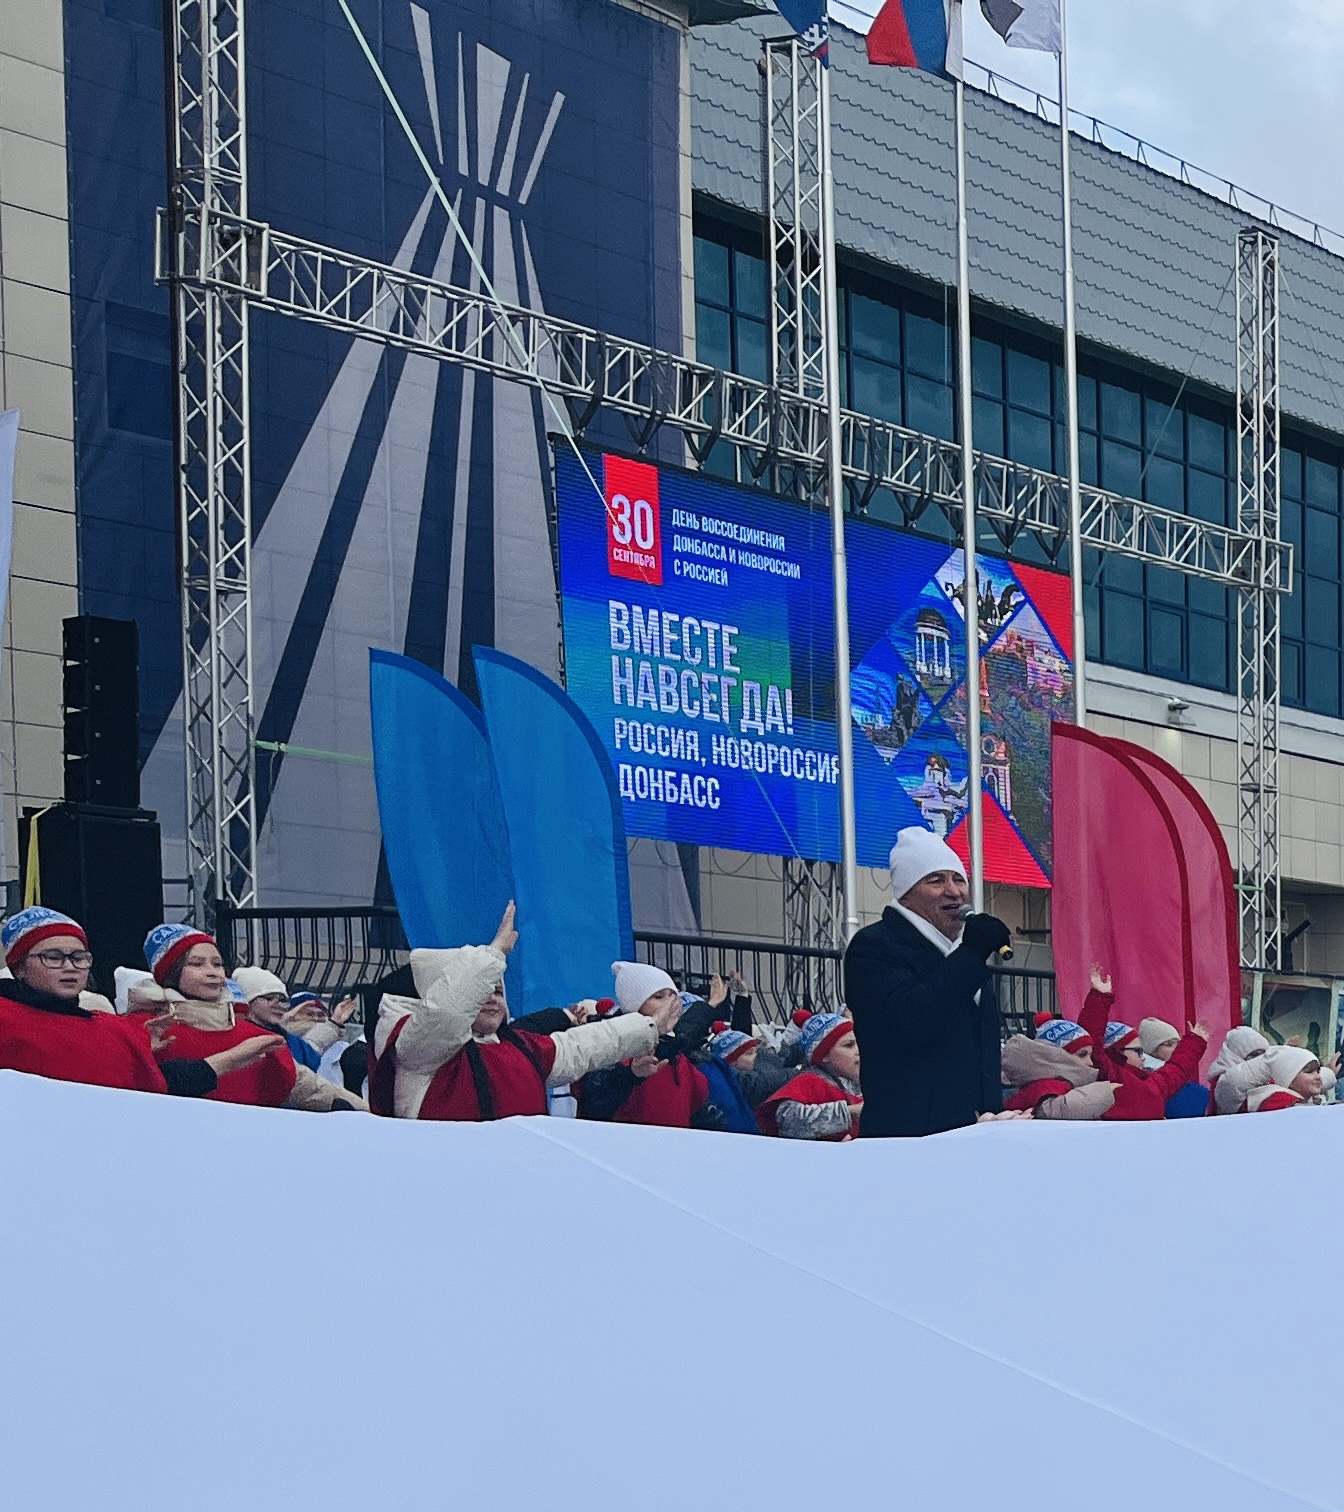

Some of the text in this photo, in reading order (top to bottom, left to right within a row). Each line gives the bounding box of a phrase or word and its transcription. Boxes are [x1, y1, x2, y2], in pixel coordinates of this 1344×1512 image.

[611, 493, 655, 550] 30
[672, 508, 786, 552] ДЕНЬ ВОССОЕДИНЕНИЯ
[612, 547, 656, 570] СЕНТЯБРЯ
[673, 534, 801, 580] ДОНБАССА И НОВОРОССИИ
[673, 559, 729, 587] С РОССИЕЙ
[608, 599, 741, 675] ВМЕСТЕ
[611, 655, 795, 736] НАВСЕГДА!
[614, 716, 707, 768] РОССИЯ,
[618, 763, 721, 811] ДОНБАСС
